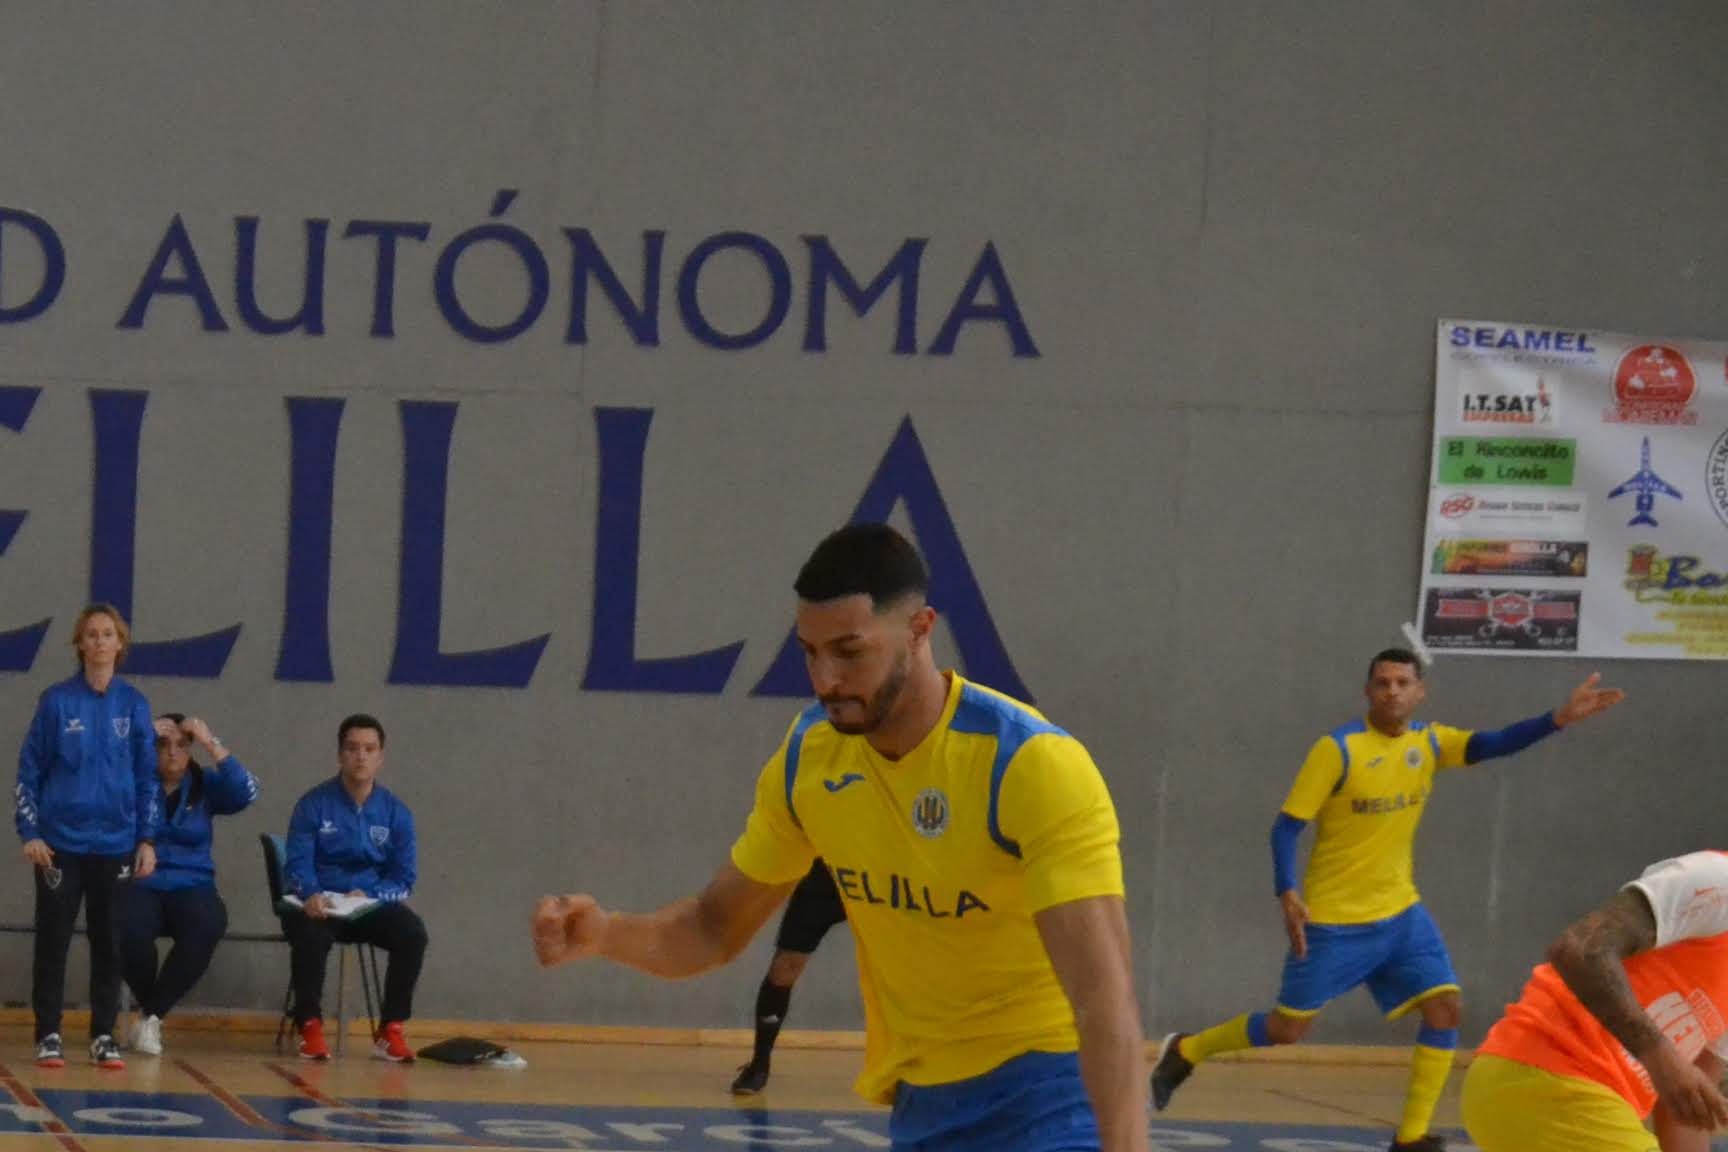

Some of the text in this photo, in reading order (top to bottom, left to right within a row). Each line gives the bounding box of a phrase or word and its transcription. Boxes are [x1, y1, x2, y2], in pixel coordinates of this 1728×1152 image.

[116, 188, 1041, 358] AUTÓNOMA
[1449, 325, 1597, 354] SEAMEL
[825, 863, 991, 918] ELILLA
